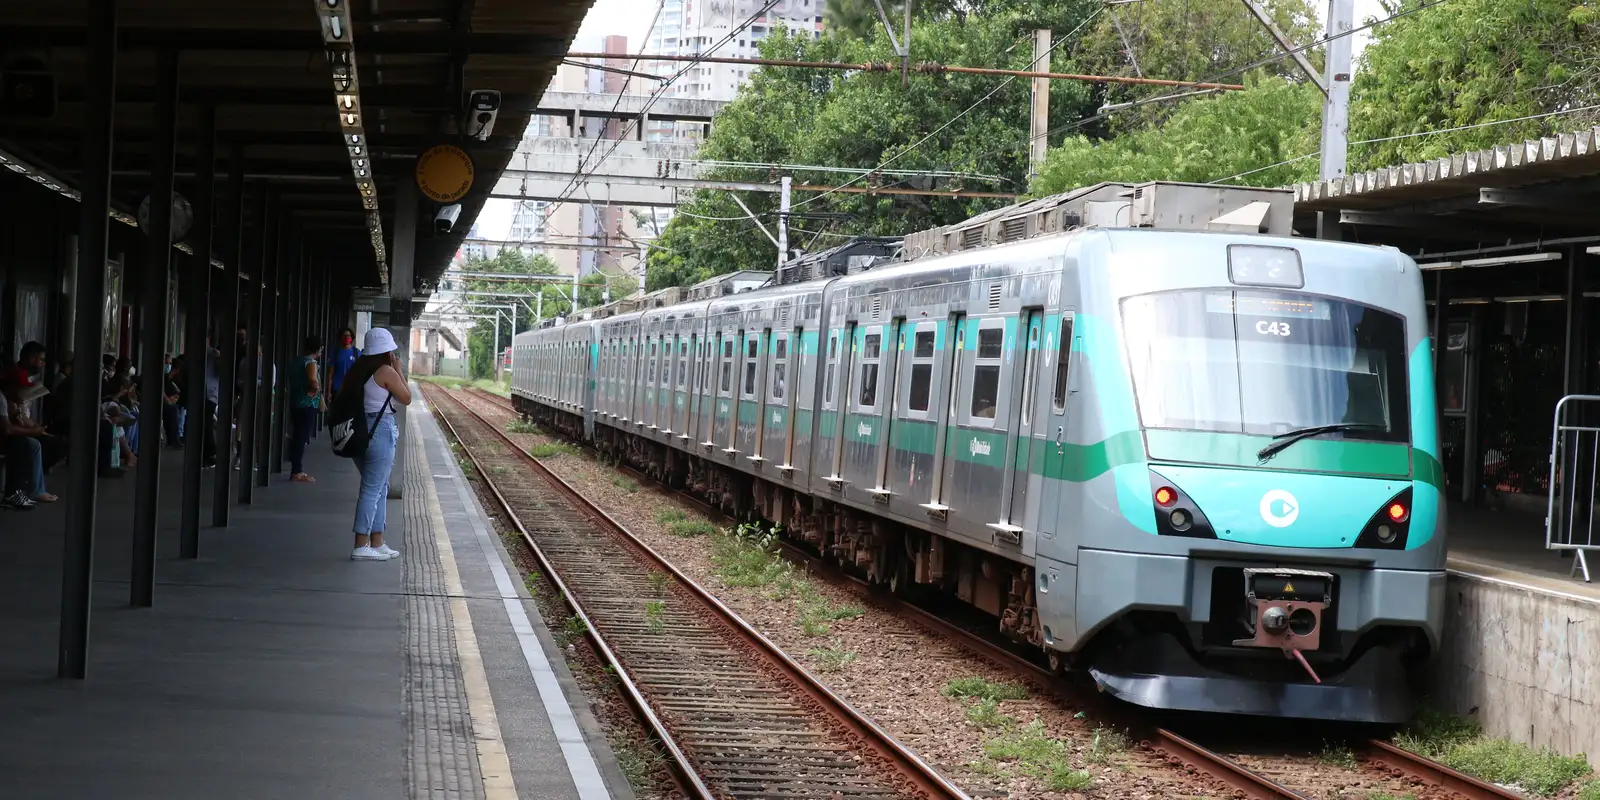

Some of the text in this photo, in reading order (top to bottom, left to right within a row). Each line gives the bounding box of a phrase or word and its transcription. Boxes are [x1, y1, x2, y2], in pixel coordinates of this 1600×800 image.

[423, 184, 441, 199] ponto
[451, 180, 470, 199] parada
[1255, 320, 1291, 337] C43
[332, 417, 355, 443] NIKE
